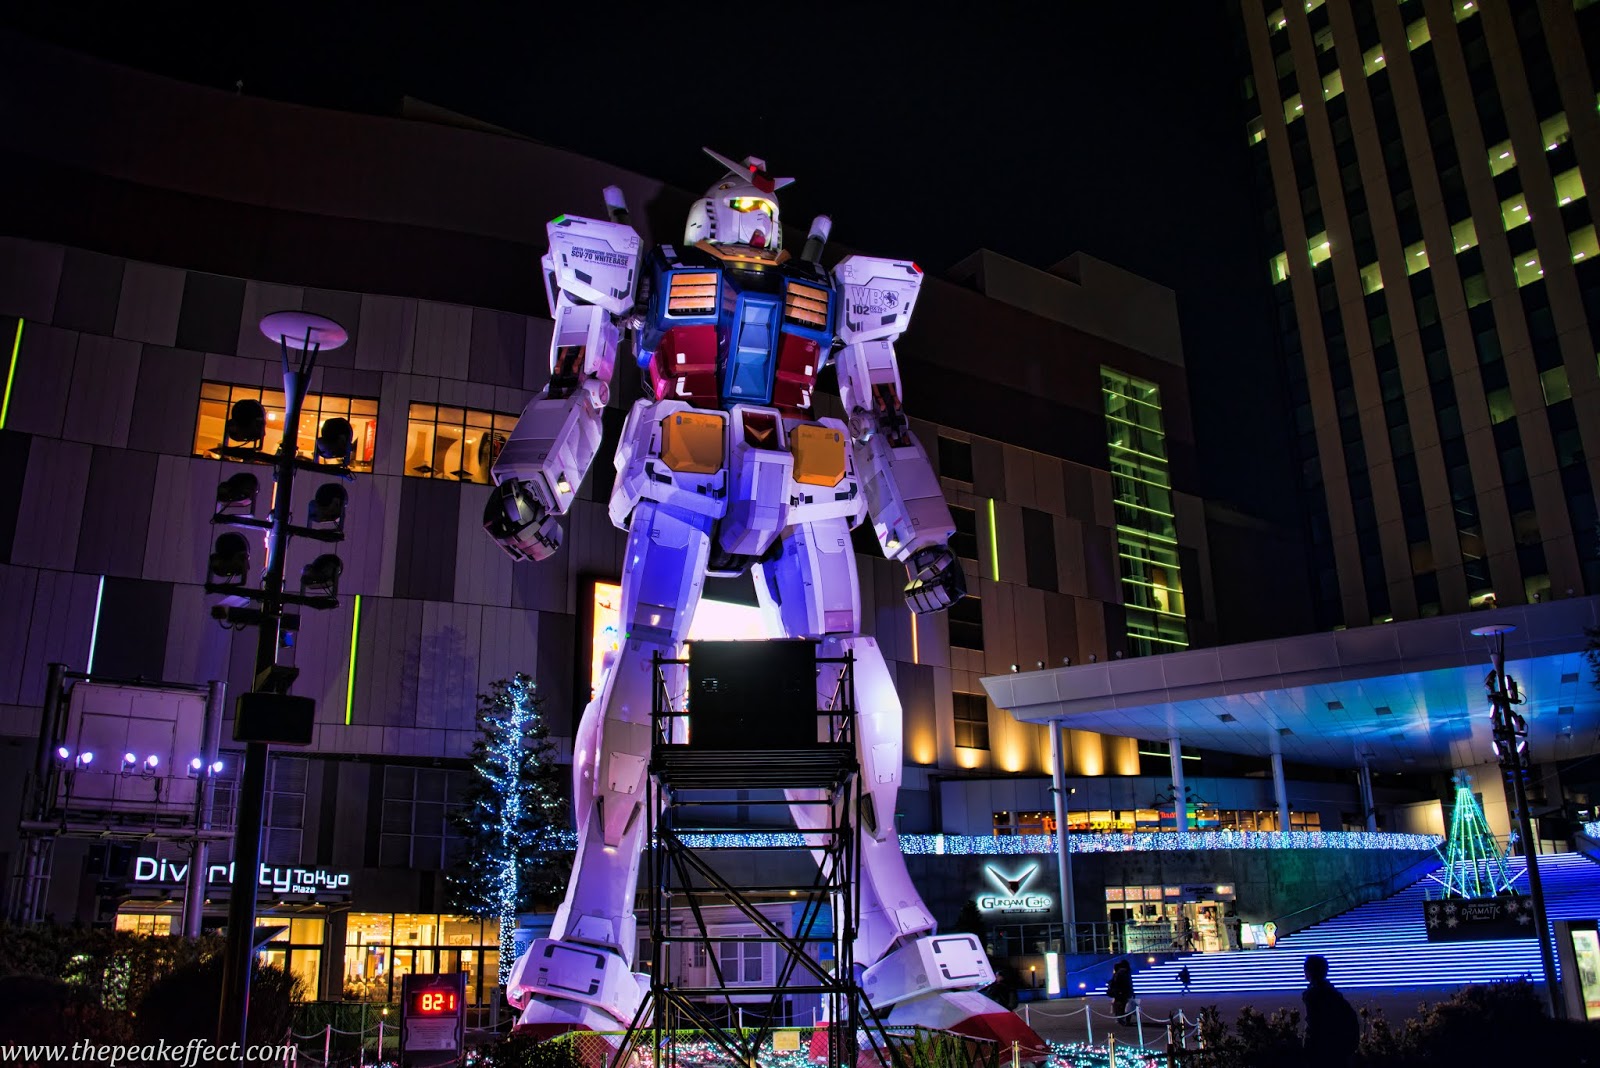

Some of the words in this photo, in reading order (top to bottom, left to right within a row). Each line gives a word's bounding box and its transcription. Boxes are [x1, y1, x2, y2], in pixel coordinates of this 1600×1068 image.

[571, 250, 593, 260] SCV-70
[594, 254, 629, 266] WHITEBASE
[851, 287, 884, 308] WB
[852, 304, 870, 315] 102
[134, 856, 291, 893] Divrty
[293, 868, 349, 889] Tokyo
[292, 885, 316, 894] Plaza
[1461, 905, 1501, 921] DRAMATIC
